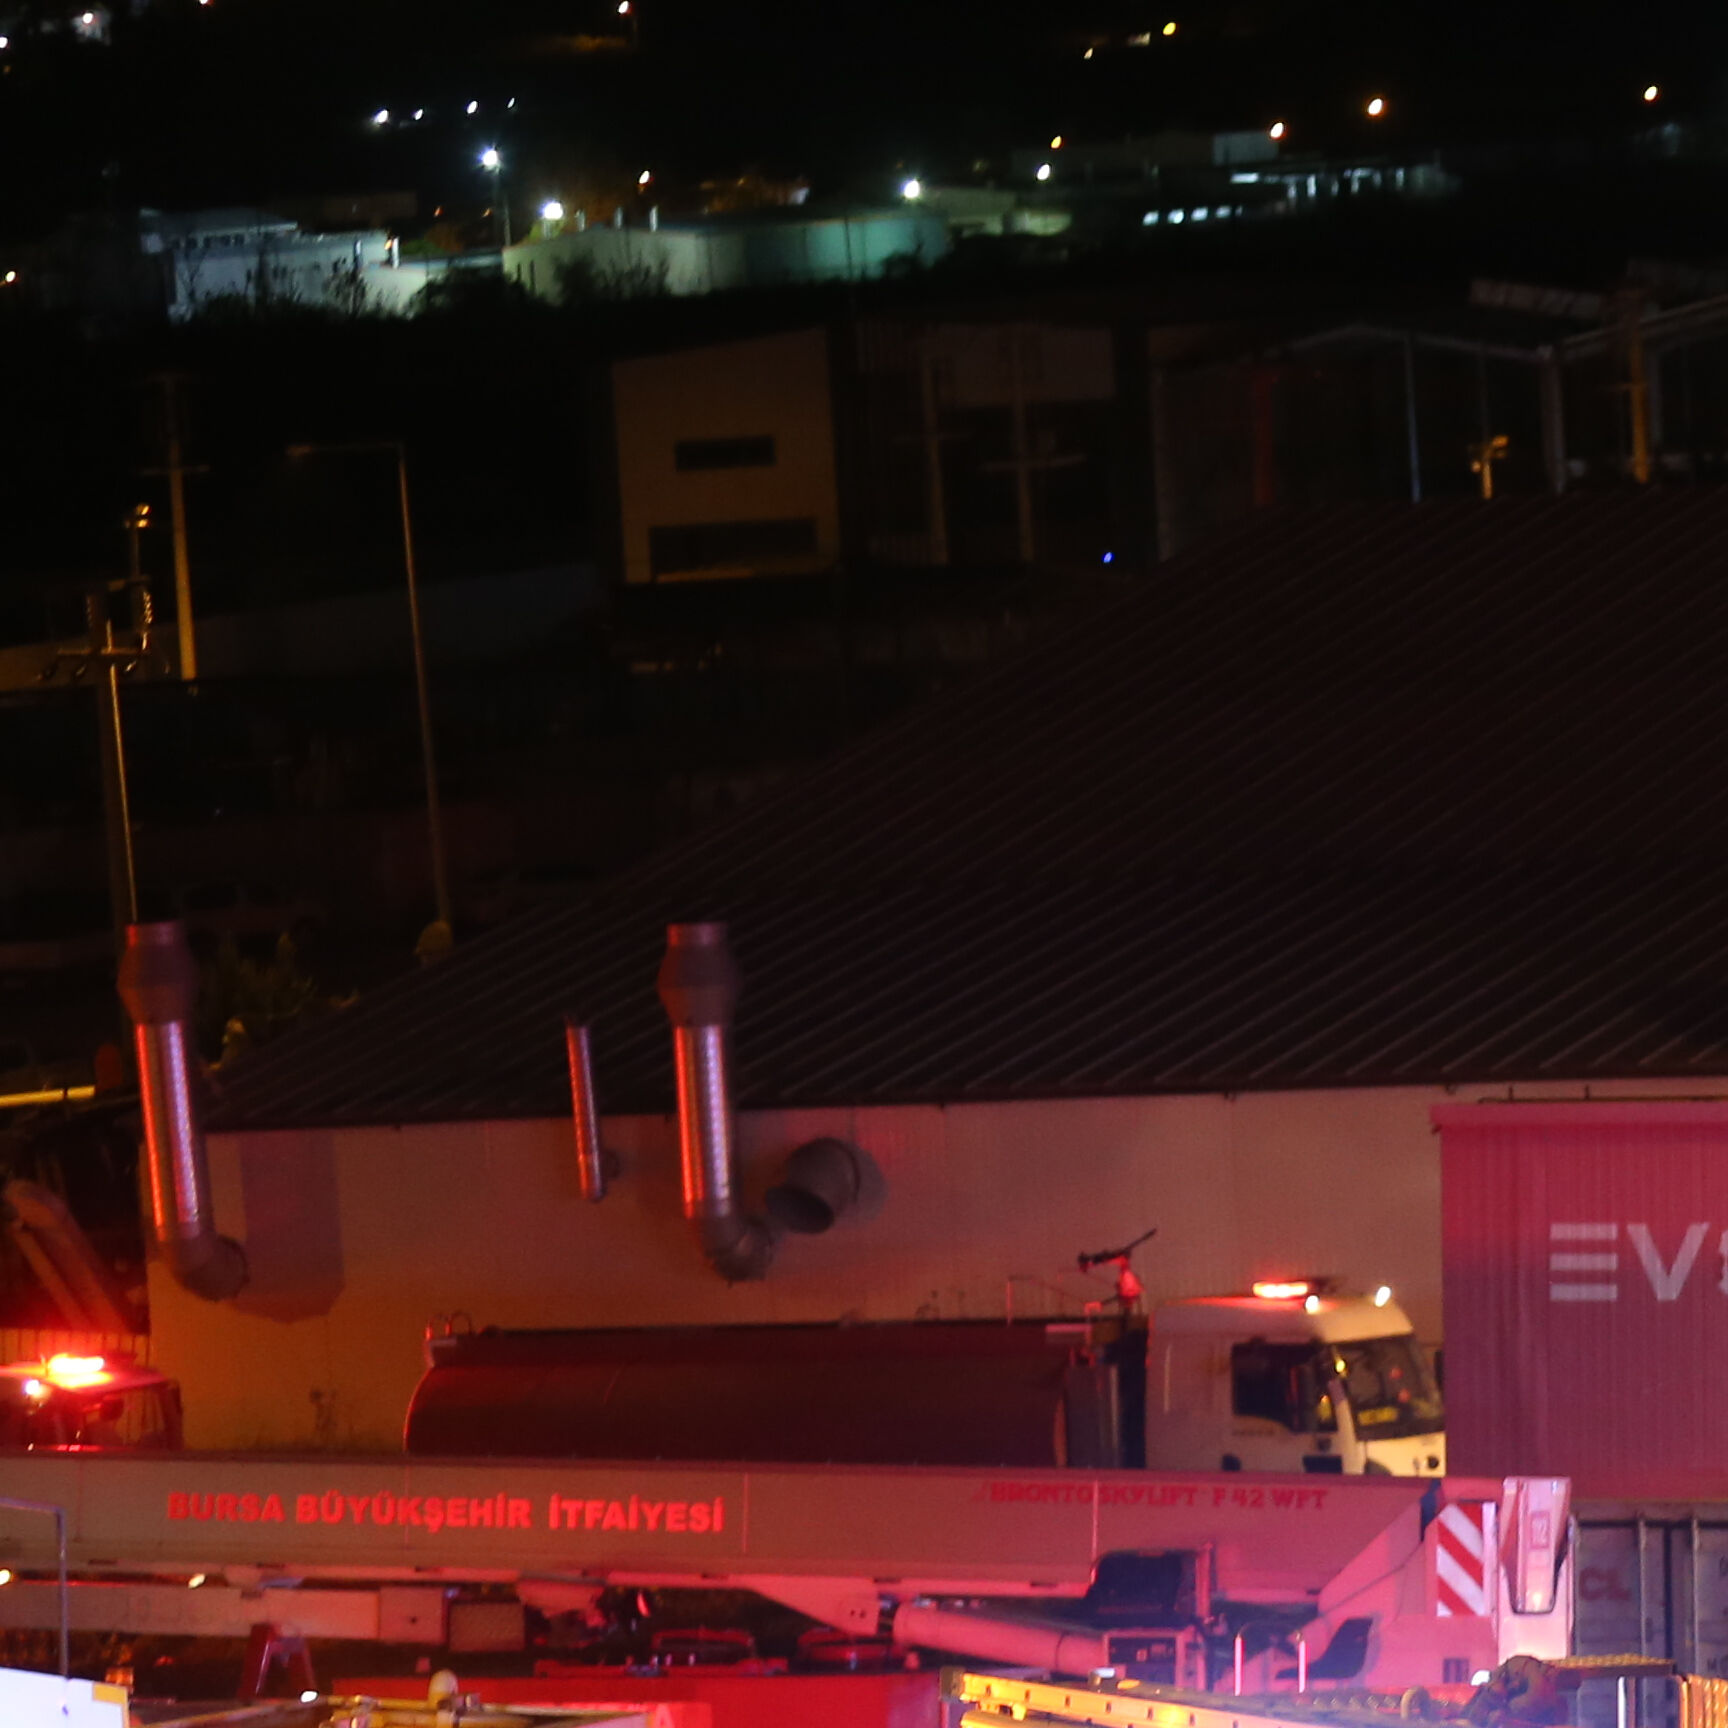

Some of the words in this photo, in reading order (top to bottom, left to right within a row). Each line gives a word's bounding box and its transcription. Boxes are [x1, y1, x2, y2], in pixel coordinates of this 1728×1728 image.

[168, 1491, 286, 1522] BURSA
[296, 1489, 533, 1534] BÜYÜKŞEHİR
[550, 1492, 725, 1533] İTFAİYESİ
